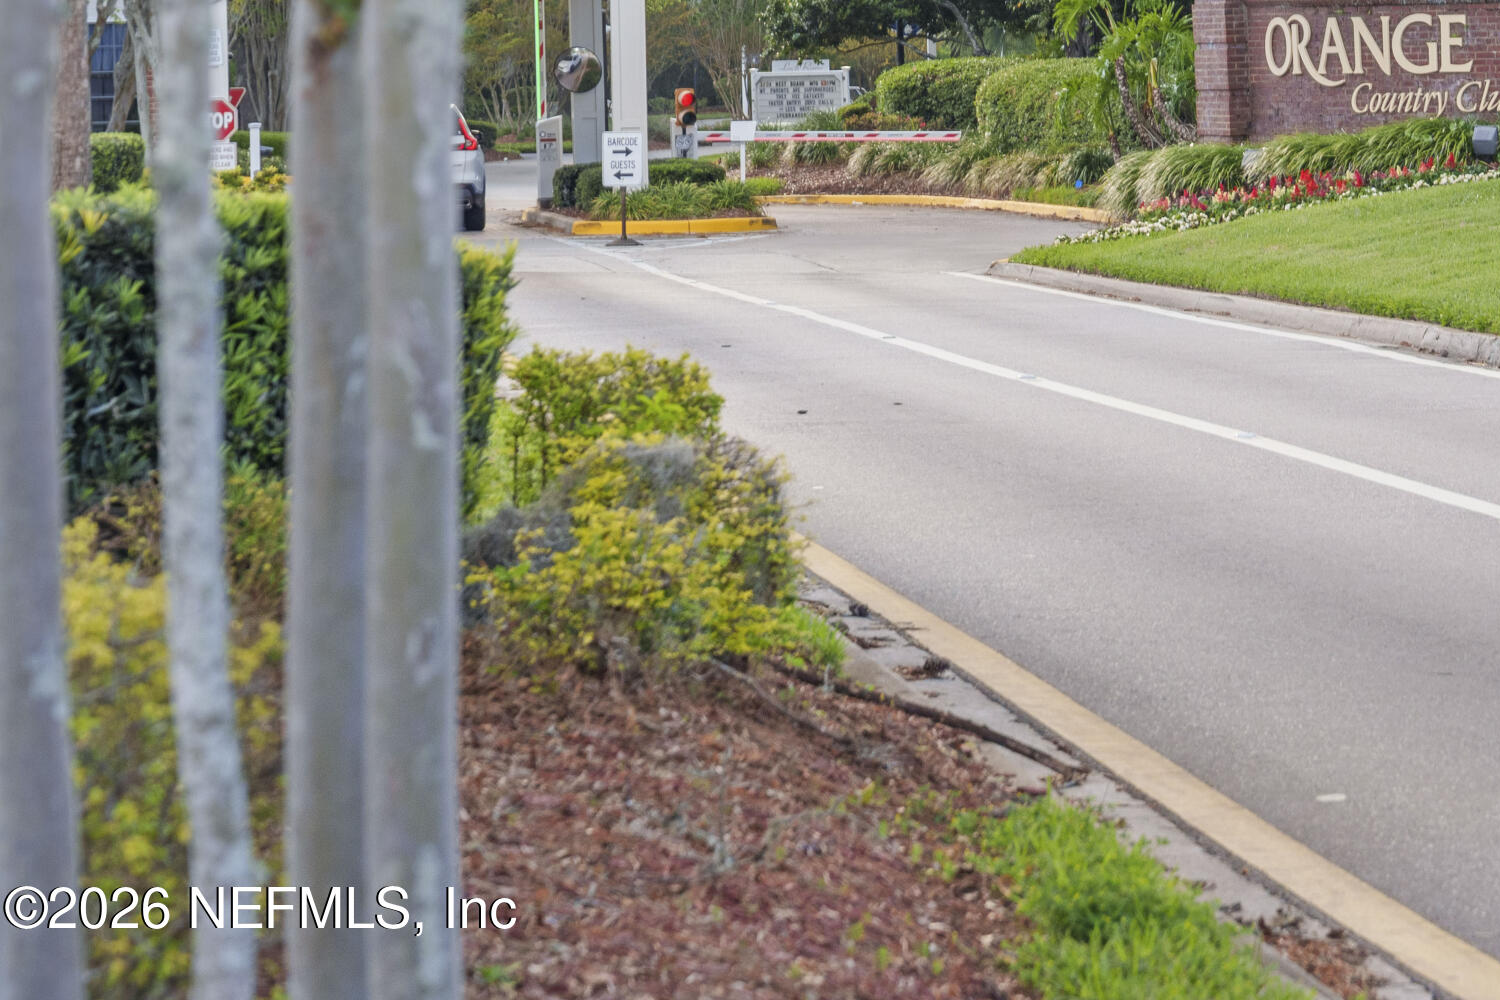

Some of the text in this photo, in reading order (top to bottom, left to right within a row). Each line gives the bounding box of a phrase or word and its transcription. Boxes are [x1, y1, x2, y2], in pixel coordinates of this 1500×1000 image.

[1265, 13, 1474, 87] ORANGE
[1351, 82, 1449, 117] Country
[607, 136, 639, 146] BARCODE
[610, 160, 636, 169] GUESTS
